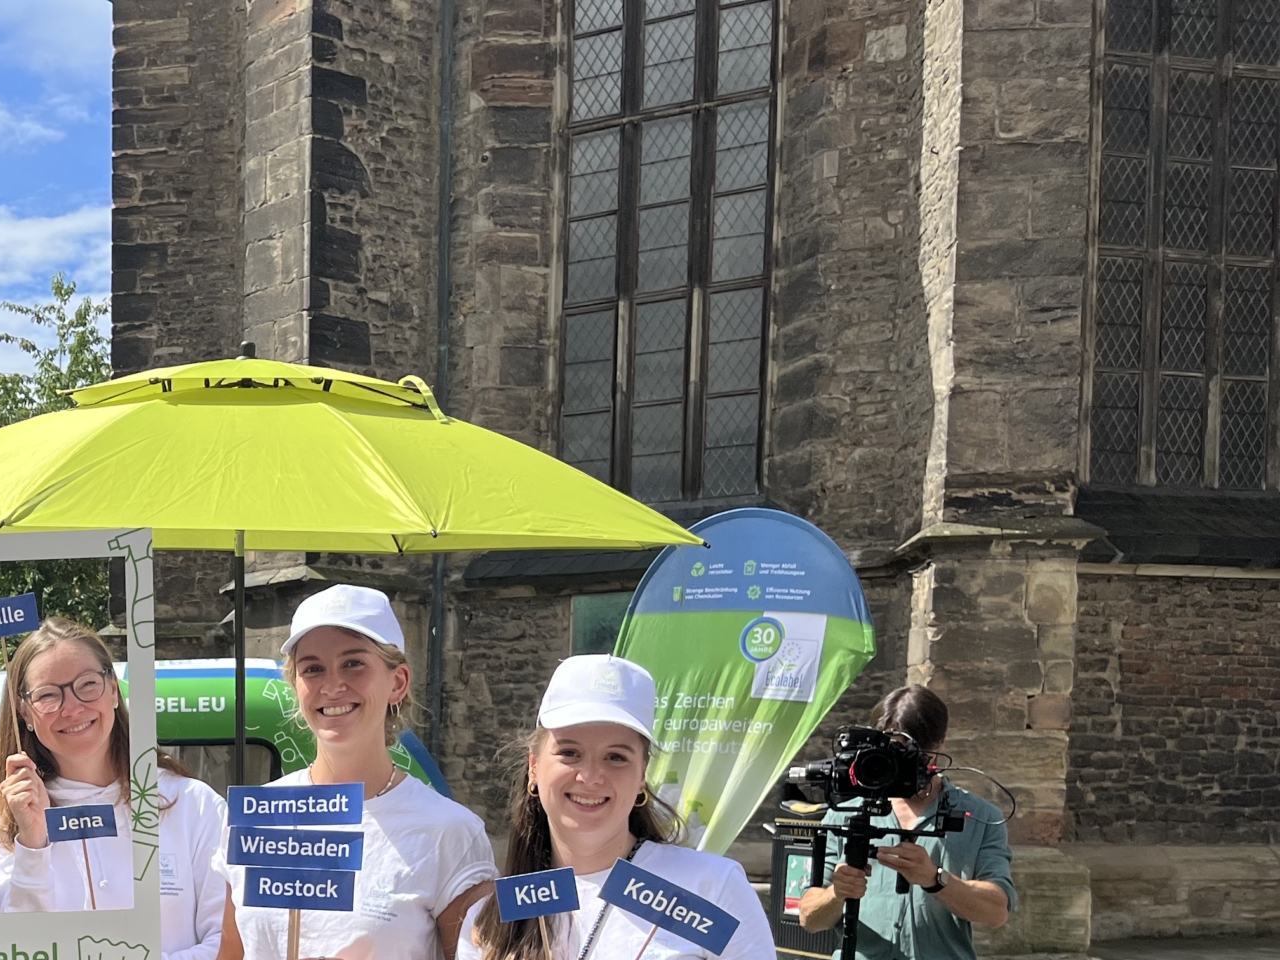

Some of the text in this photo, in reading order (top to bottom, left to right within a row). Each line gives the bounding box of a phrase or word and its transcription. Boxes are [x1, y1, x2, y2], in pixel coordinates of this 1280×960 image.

[751, 627, 775, 645] 30
[750, 646, 774, 654] JAHRE
[765, 671, 804, 689] Ecolabel
[155, 696, 226, 713] BEL.EU
[654, 692, 735, 710] as Zeichen
[663, 717, 774, 736] europaweiten
[655, 736, 747, 755] weltschutz
[242, 793, 349, 814] Darmstadt
[58, 814, 104, 831] Jena
[240, 835, 350, 858] Wiesbaden
[258, 877, 339, 898] Rostock
[514, 880, 559, 906] Kiel
[622, 877, 714, 934] Koblenz
